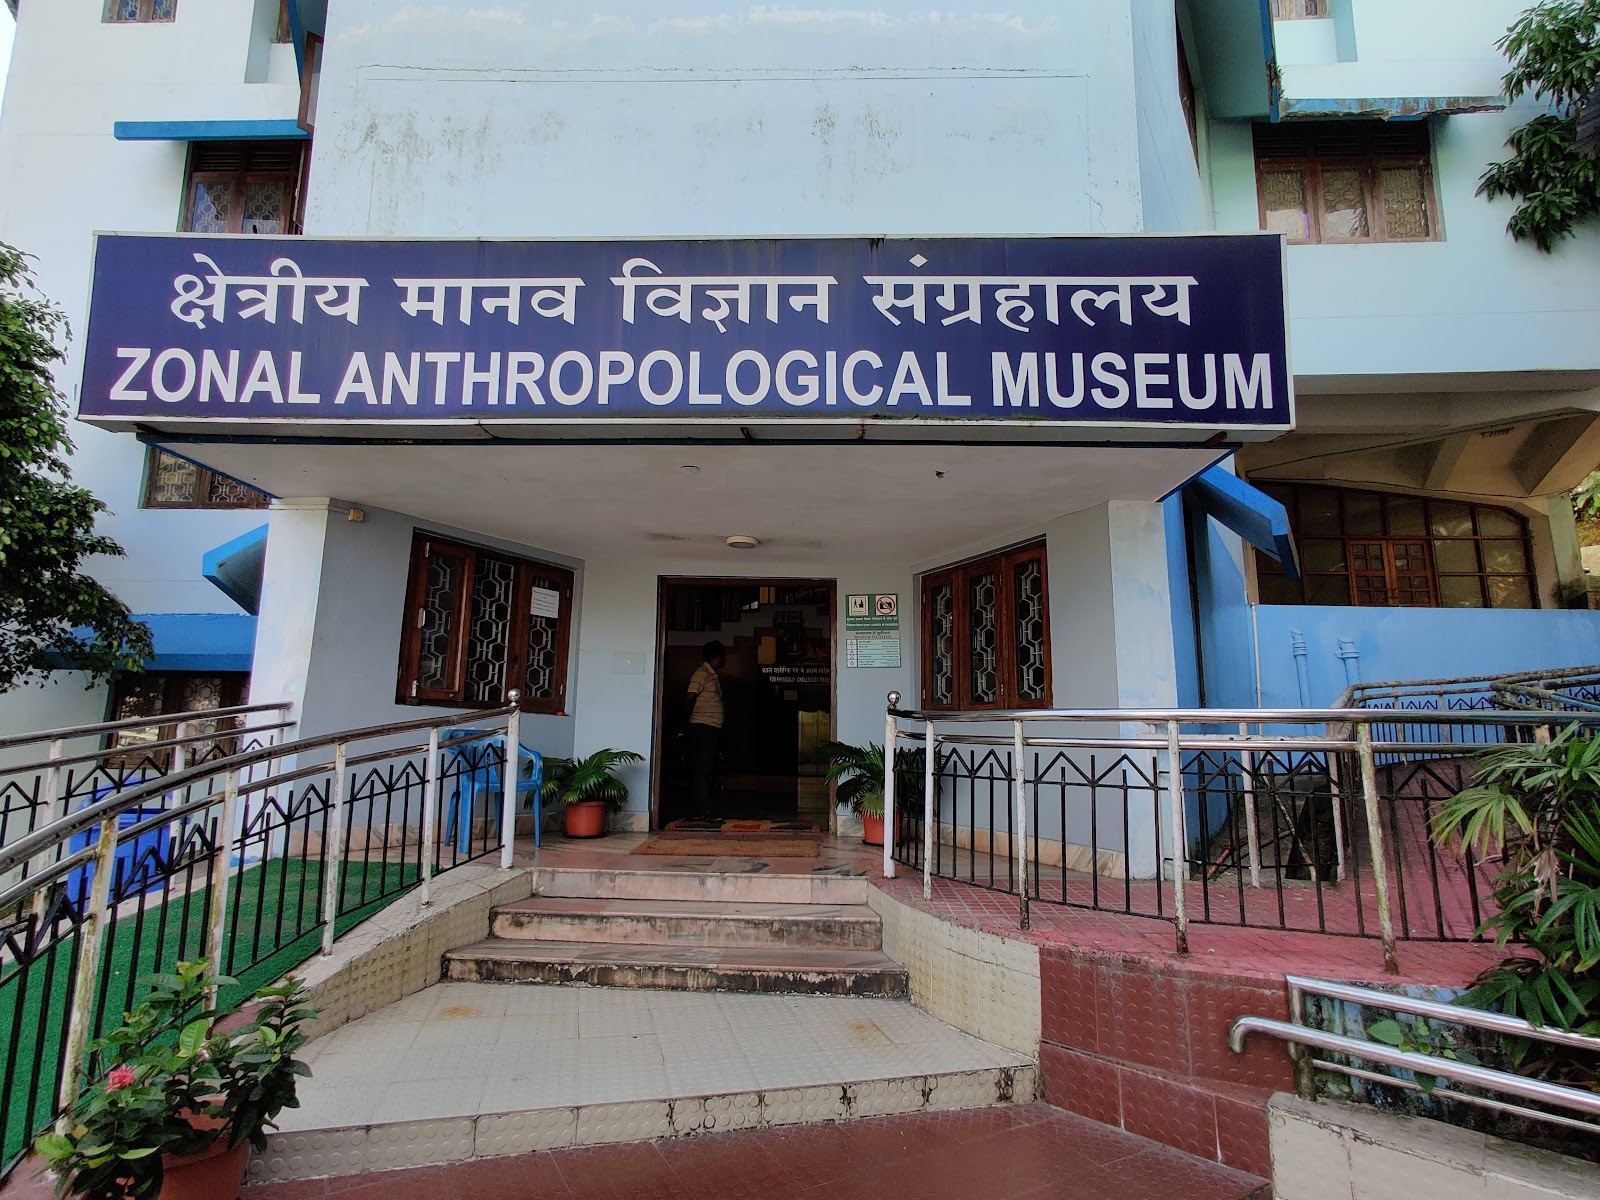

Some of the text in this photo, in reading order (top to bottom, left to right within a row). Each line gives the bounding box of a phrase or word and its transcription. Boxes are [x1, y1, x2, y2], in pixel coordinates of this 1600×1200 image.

[171, 253, 1198, 333] क्षेत्रीय मानव विज्ञान संग्रहालय
[110, 348, 1273, 410] ZONAL ANTHROPOLOGICAL MUSEUM
